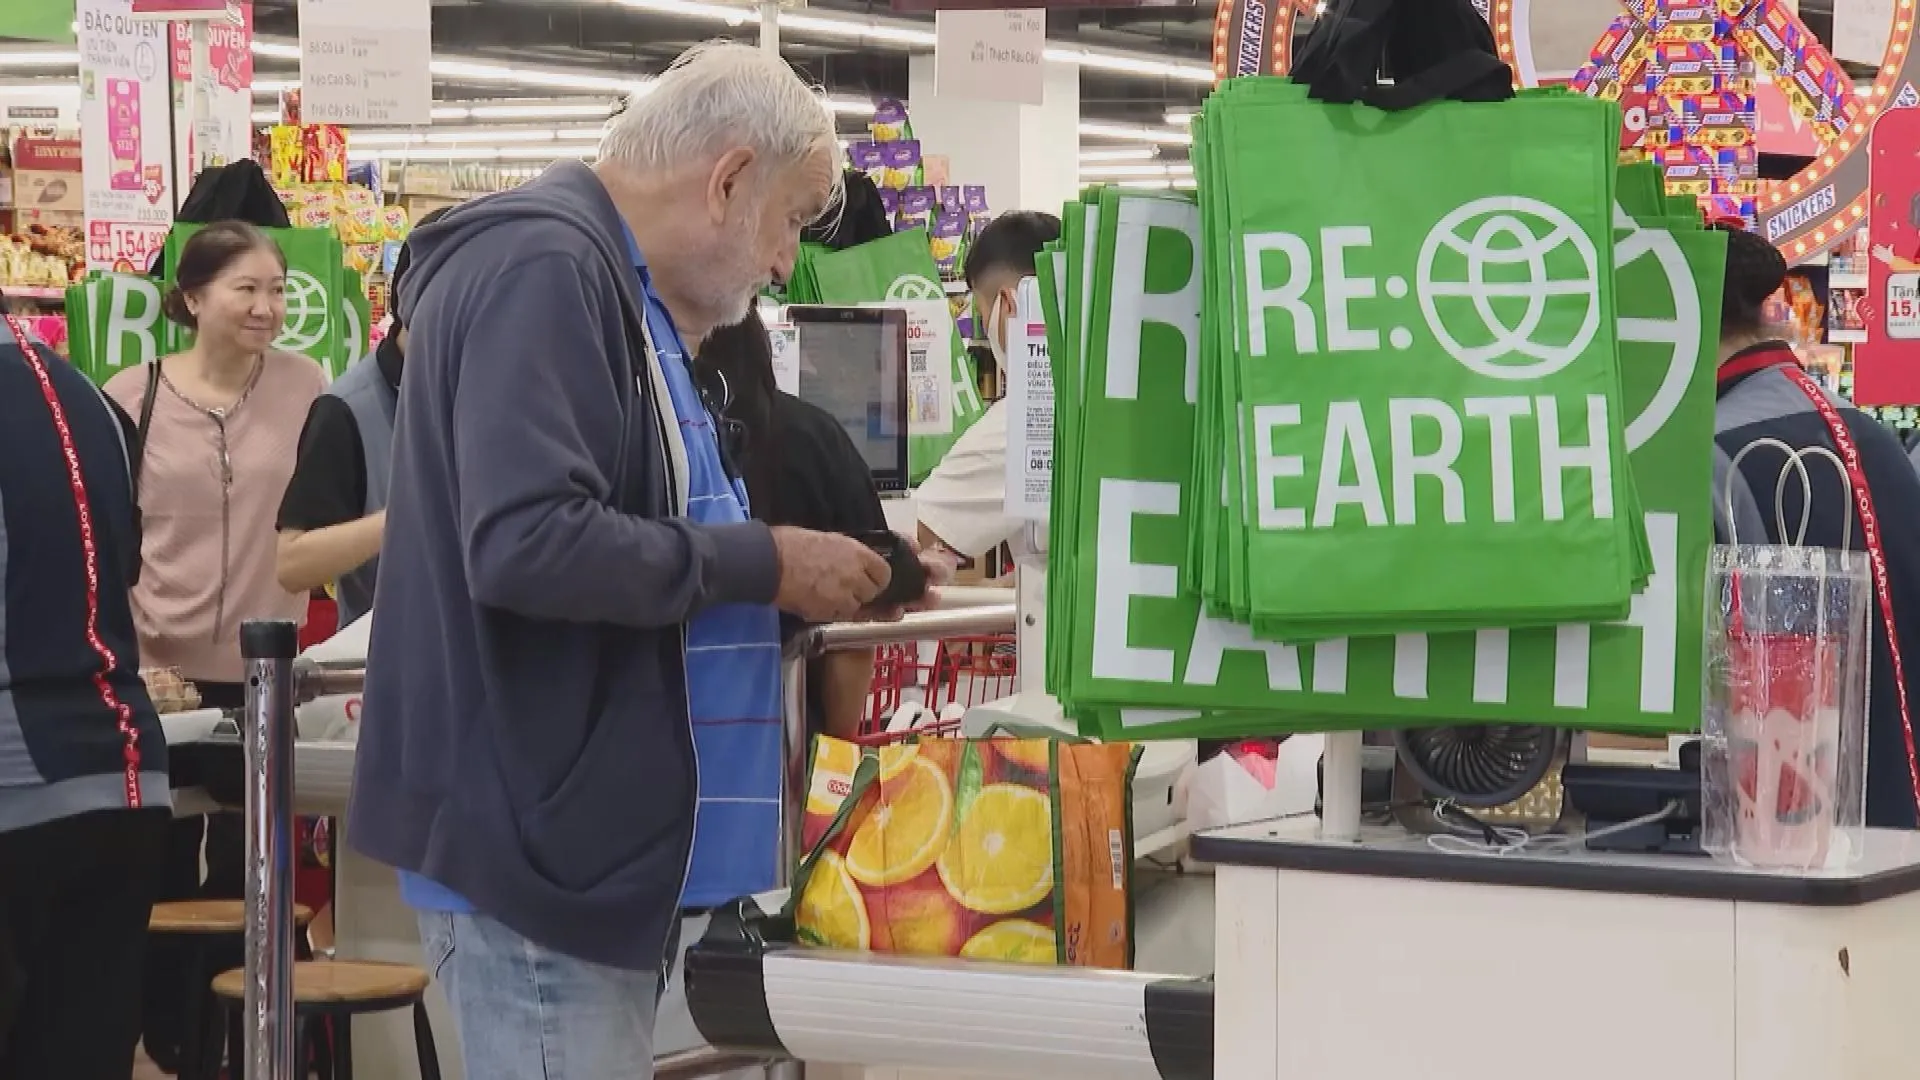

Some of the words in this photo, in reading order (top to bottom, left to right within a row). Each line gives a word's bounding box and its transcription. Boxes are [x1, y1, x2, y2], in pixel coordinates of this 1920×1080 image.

[1238, 1, 1264, 77] NICKERS
[1768, 185, 1834, 241] SNICKERS
[1242, 225, 1414, 357] RE:
[1890, 301, 1920, 319] 15,
[1031, 459, 1053, 470] 08:0
[1253, 393, 1615, 531] EARTH
[1833, 422, 1858, 472] MART
[1855, 487, 1876, 541] LOTTE
[1869, 546, 1887, 600] MART
